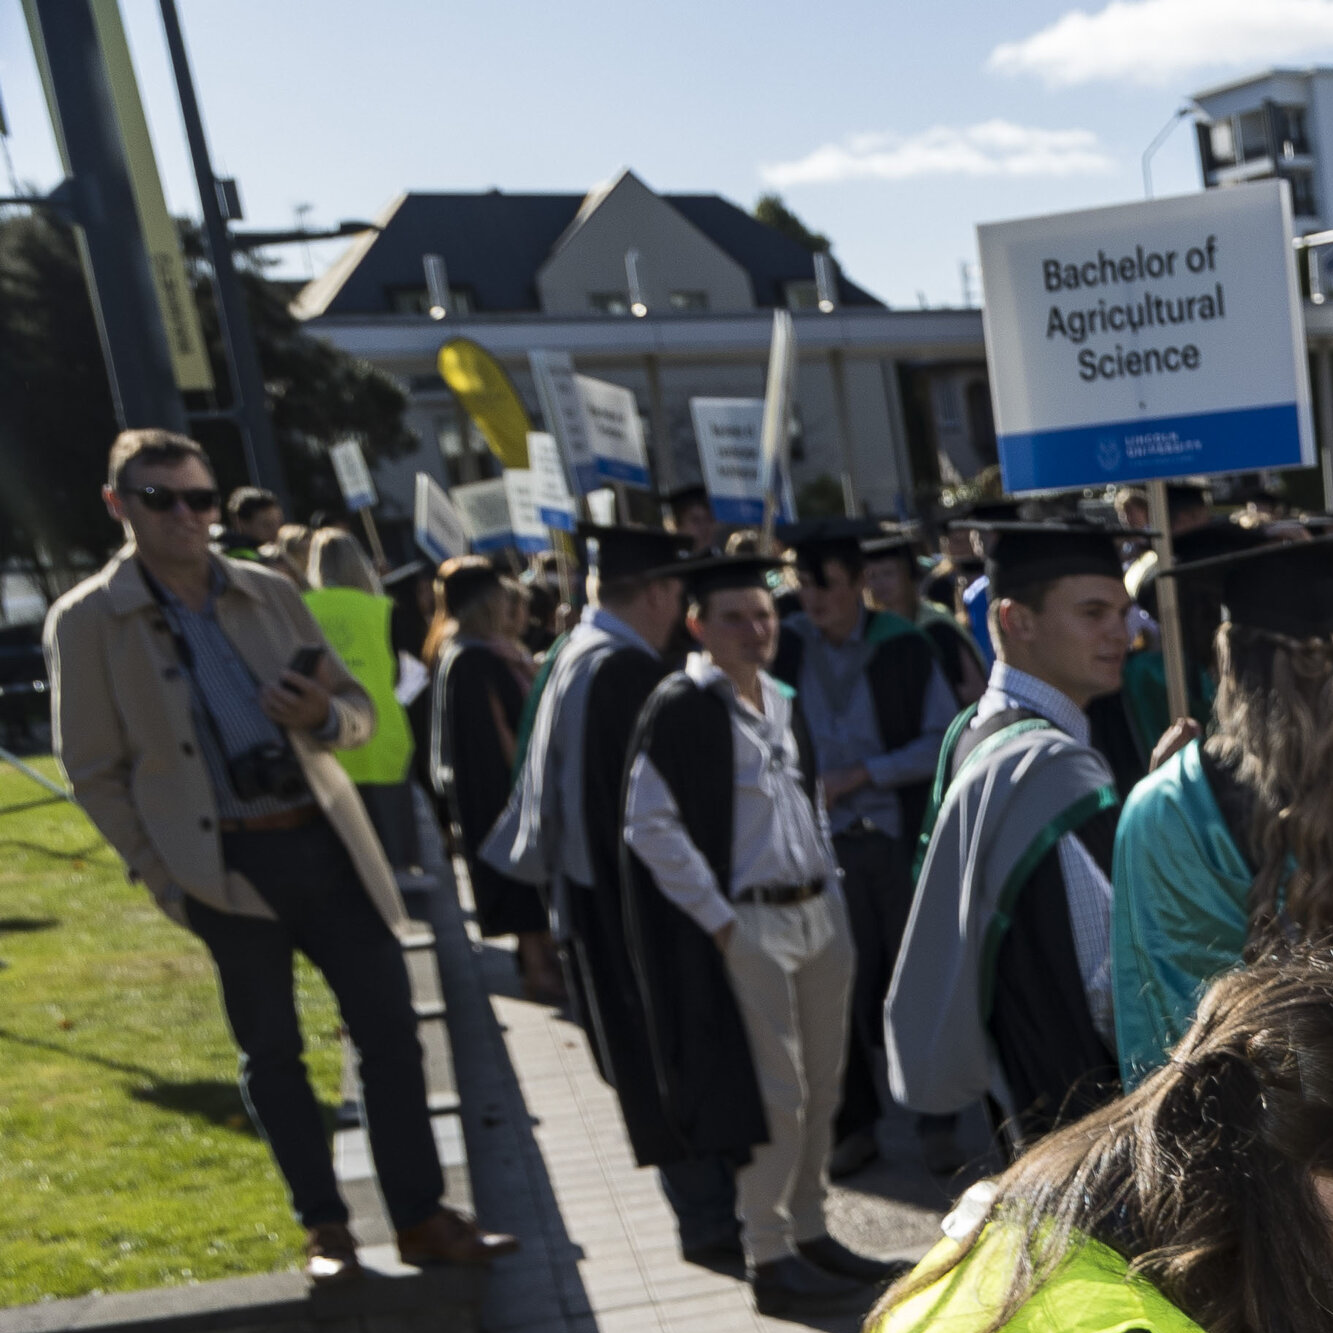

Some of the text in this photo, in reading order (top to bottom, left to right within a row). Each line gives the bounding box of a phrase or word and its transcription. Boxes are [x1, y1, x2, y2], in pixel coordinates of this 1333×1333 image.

[1043, 235, 1216, 291] Bachelor of
[1047, 282, 1224, 343] Agricultural
[1078, 344, 1200, 381] Science
